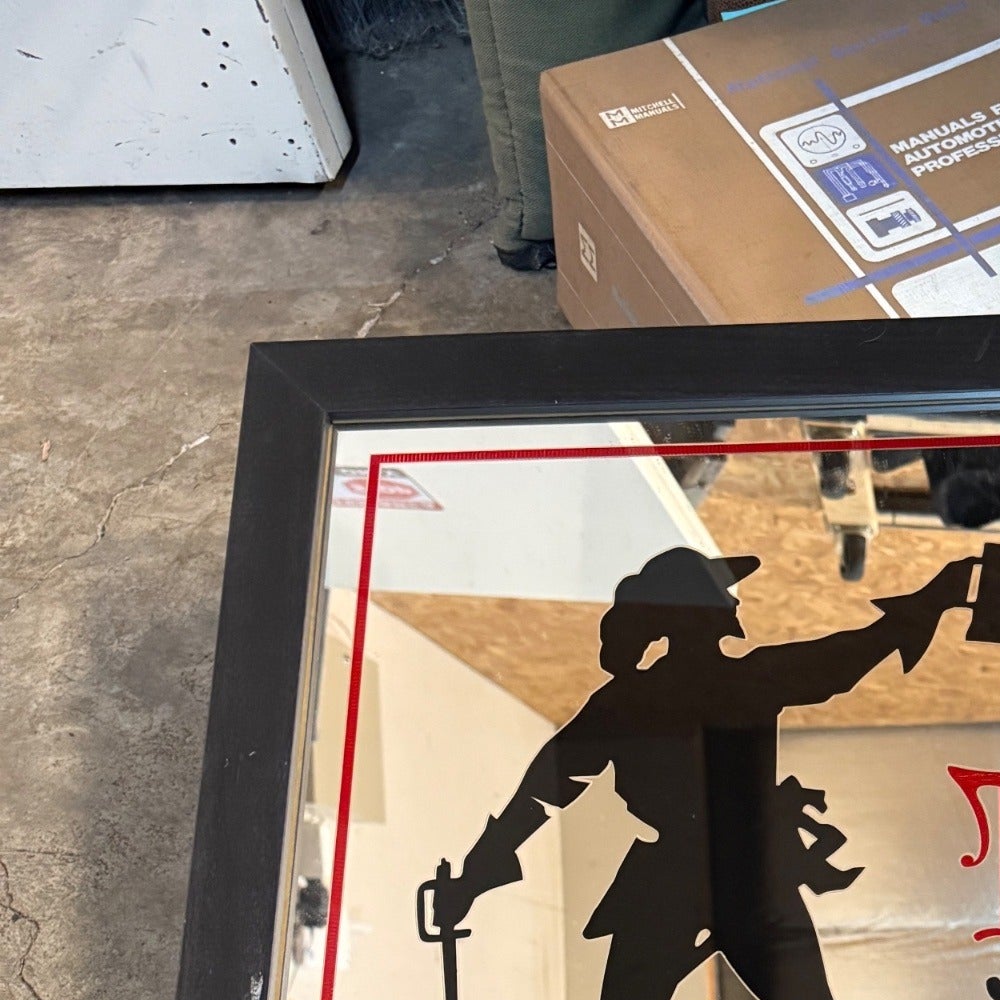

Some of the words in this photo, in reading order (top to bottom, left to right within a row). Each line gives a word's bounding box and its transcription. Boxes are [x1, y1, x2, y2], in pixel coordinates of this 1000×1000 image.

[630, 98, 675, 114] MITCHELL
[633, 104, 680, 121] MANUALS
[890, 111, 987, 154] MANUALS
